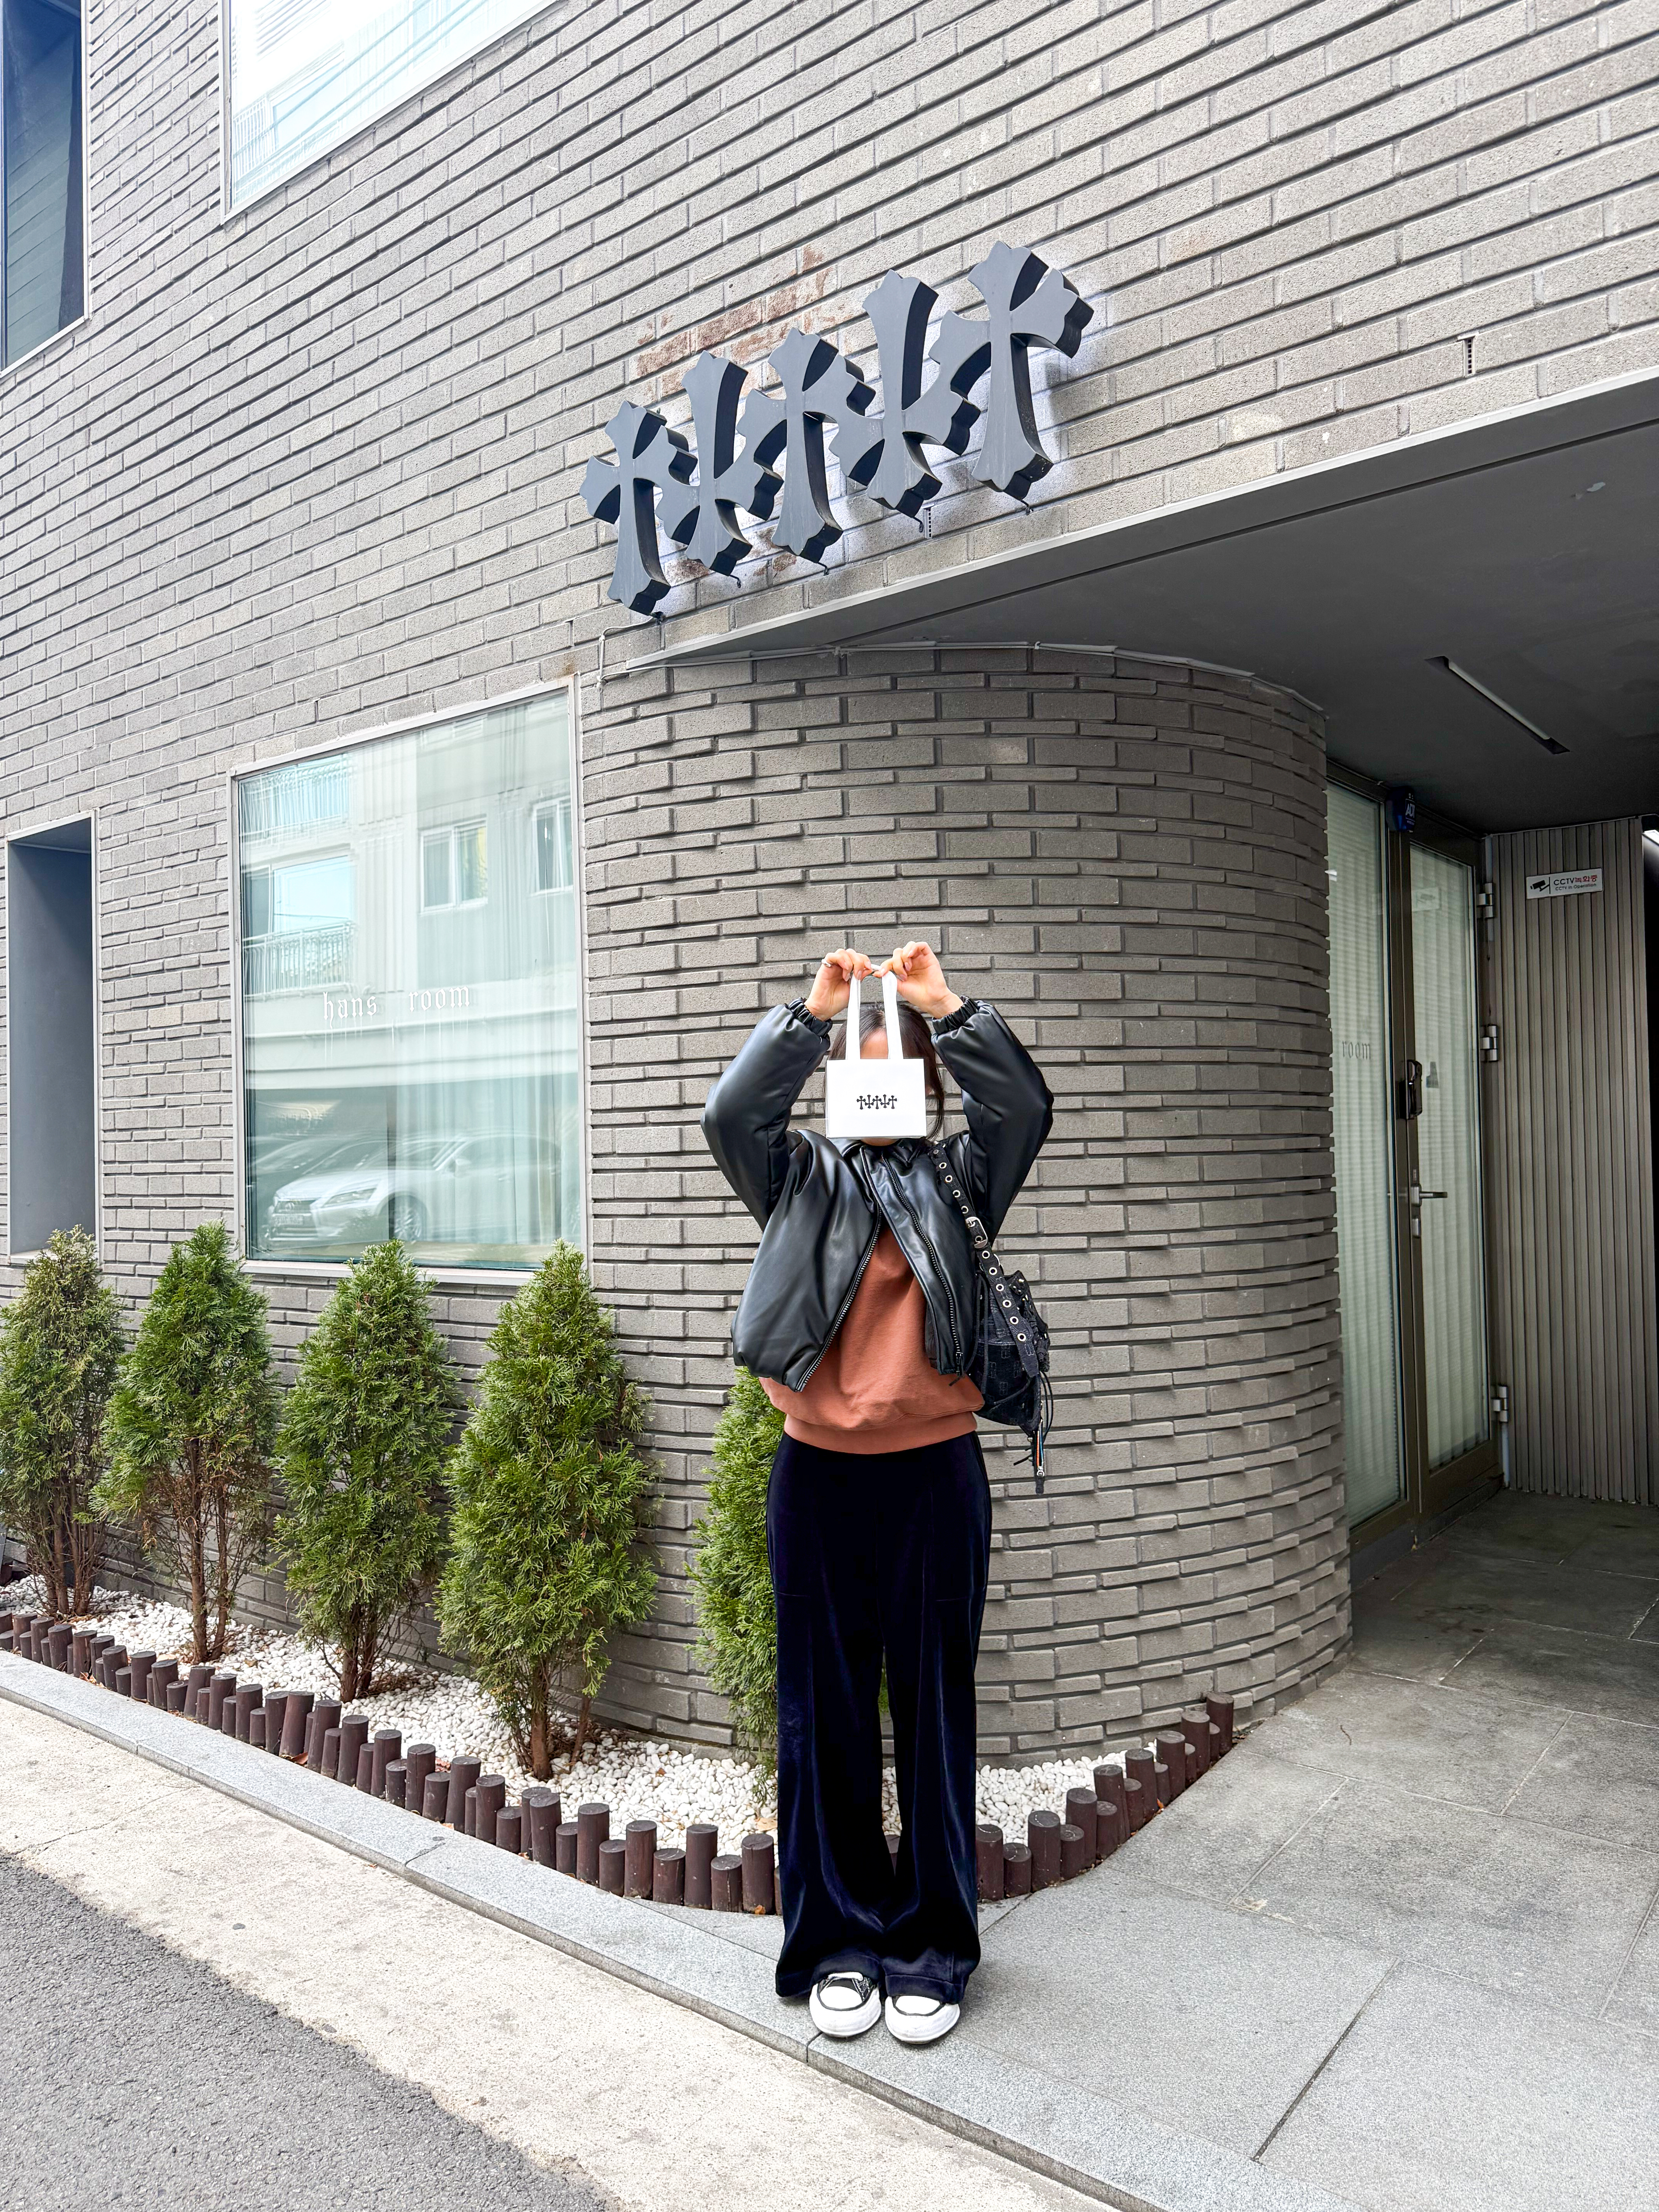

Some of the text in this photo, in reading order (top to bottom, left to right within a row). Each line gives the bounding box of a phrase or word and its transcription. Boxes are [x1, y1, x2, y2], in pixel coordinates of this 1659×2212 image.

[323, 986, 470, 1029] hans room
[1342, 1041, 1371, 1060] room
